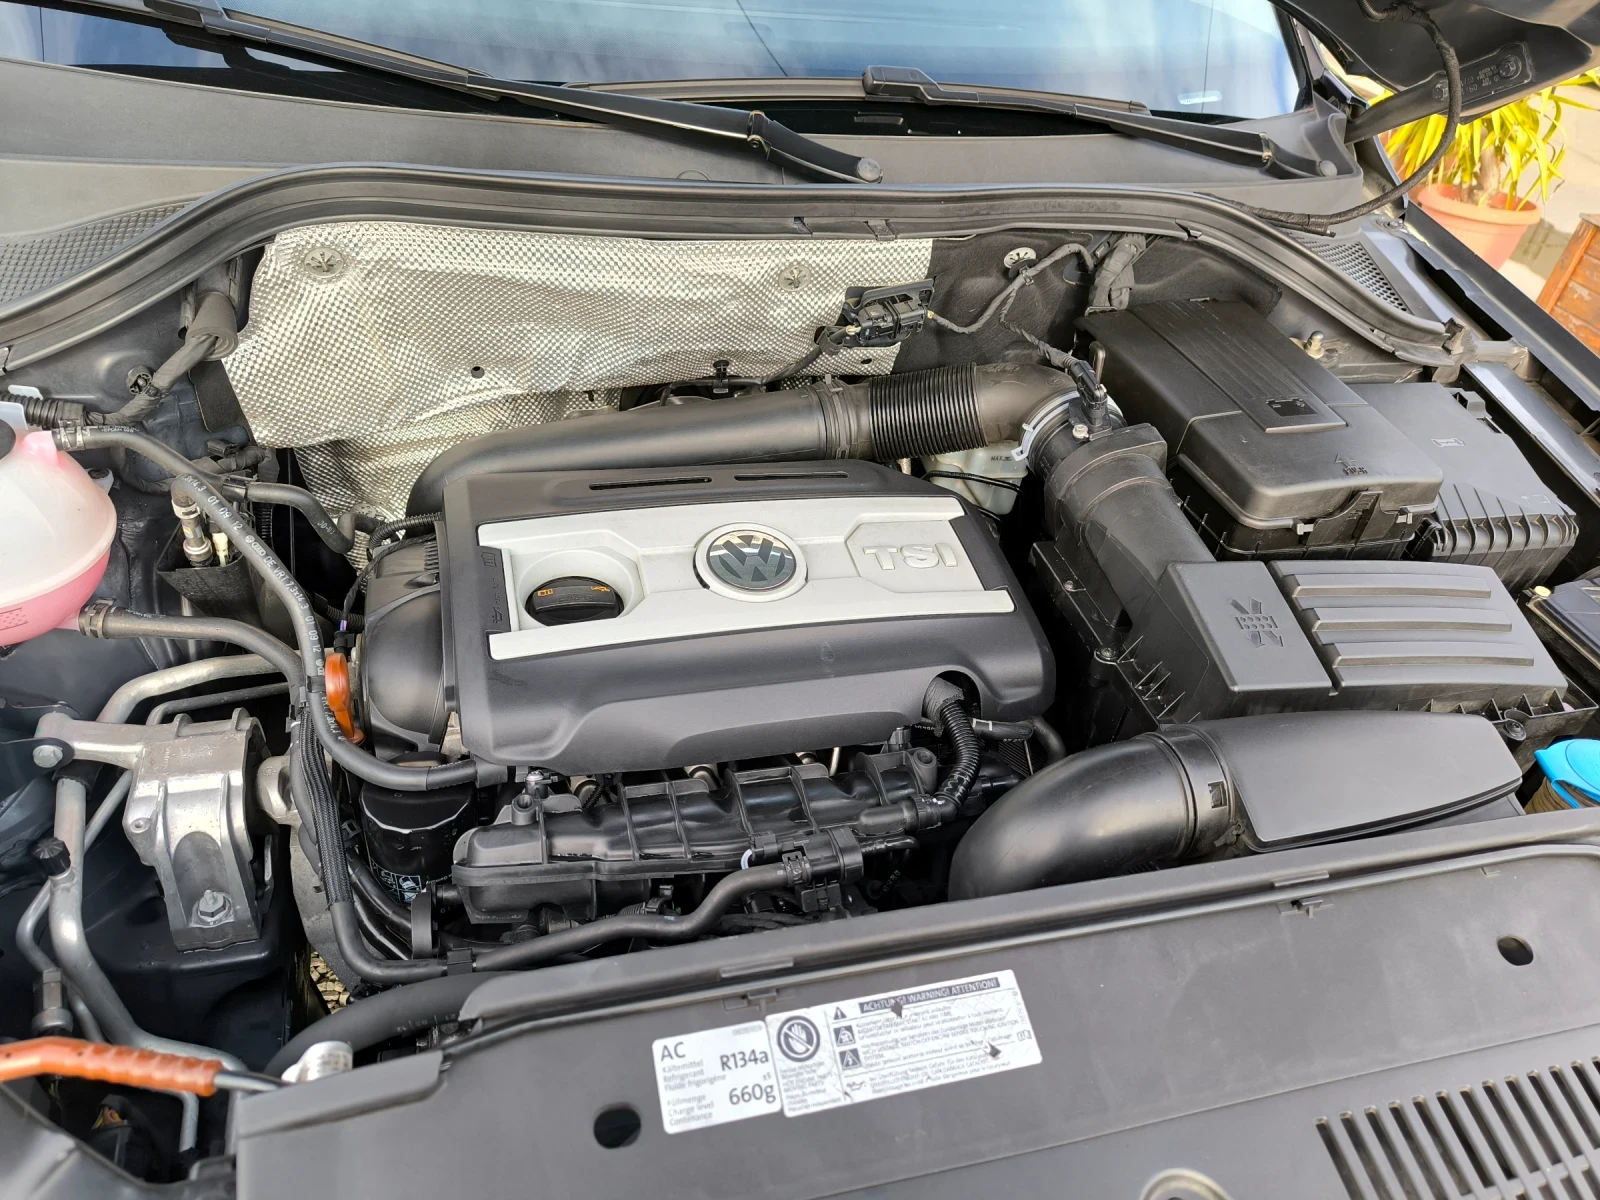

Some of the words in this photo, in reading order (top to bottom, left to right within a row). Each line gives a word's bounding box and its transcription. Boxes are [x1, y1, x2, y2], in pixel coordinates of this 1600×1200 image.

[863, 543, 958, 570] TSI
[907, 988, 950, 1003] WARNING!
[951, 978, 998, 995] ATTENTION!
[660, 1041, 686, 1062] AC
[719, 1049, 769, 1071] R134a
[663, 1069, 705, 1084] Refrigerant
[728, 1083, 777, 1105] 660g
[696, 1101, 715, 1110] level
